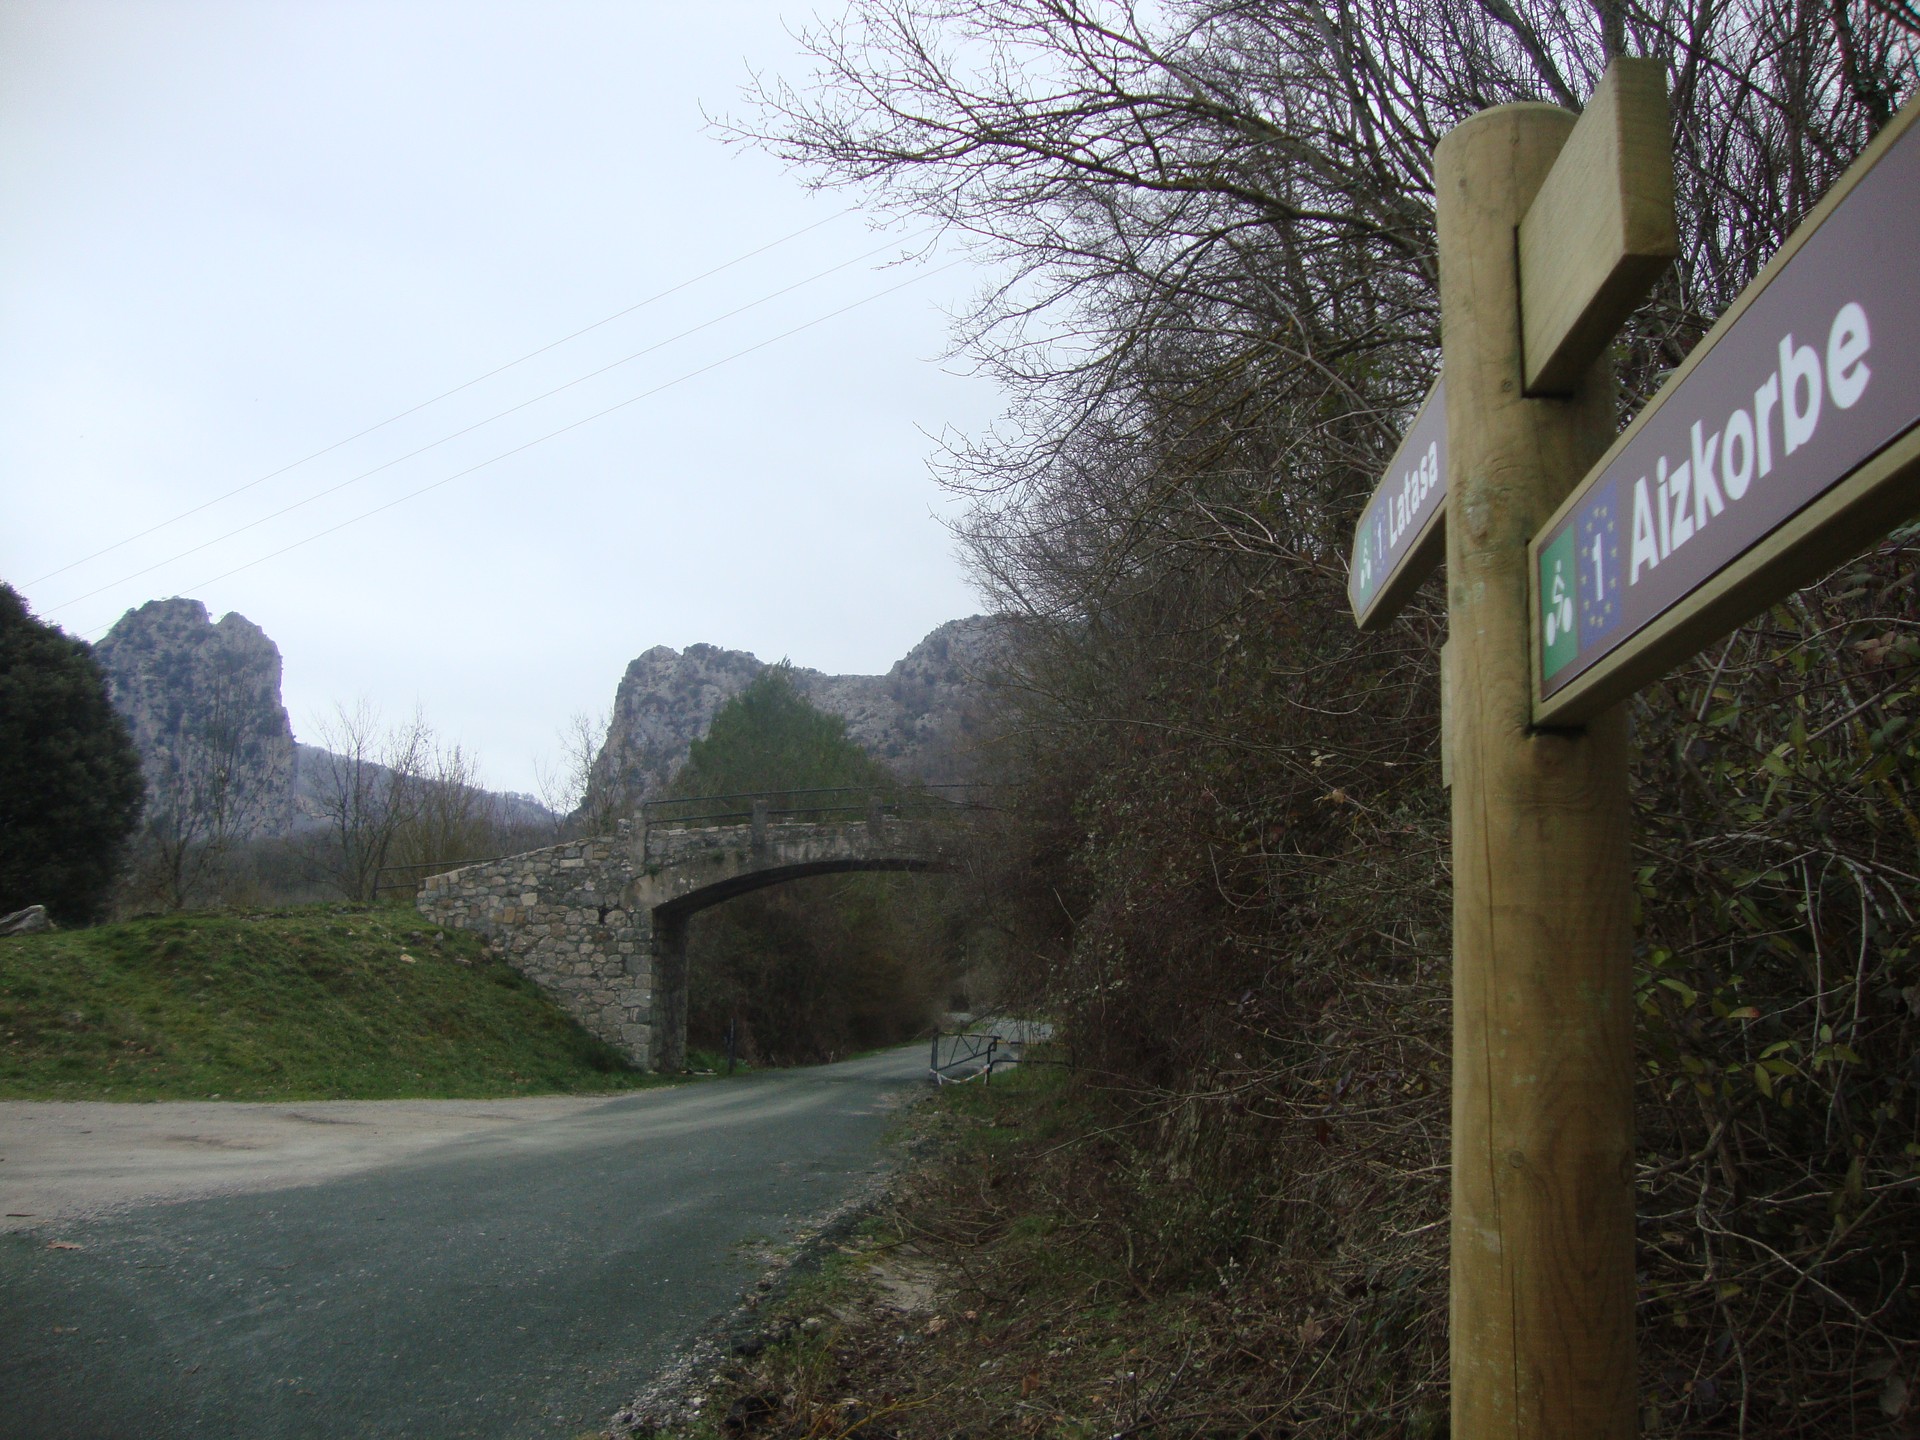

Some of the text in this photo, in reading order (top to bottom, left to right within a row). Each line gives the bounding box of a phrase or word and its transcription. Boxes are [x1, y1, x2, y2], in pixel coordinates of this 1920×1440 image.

[1388, 440, 1438, 548] Latasa
[1592, 301, 1872, 601] 1 Aizkorbe
